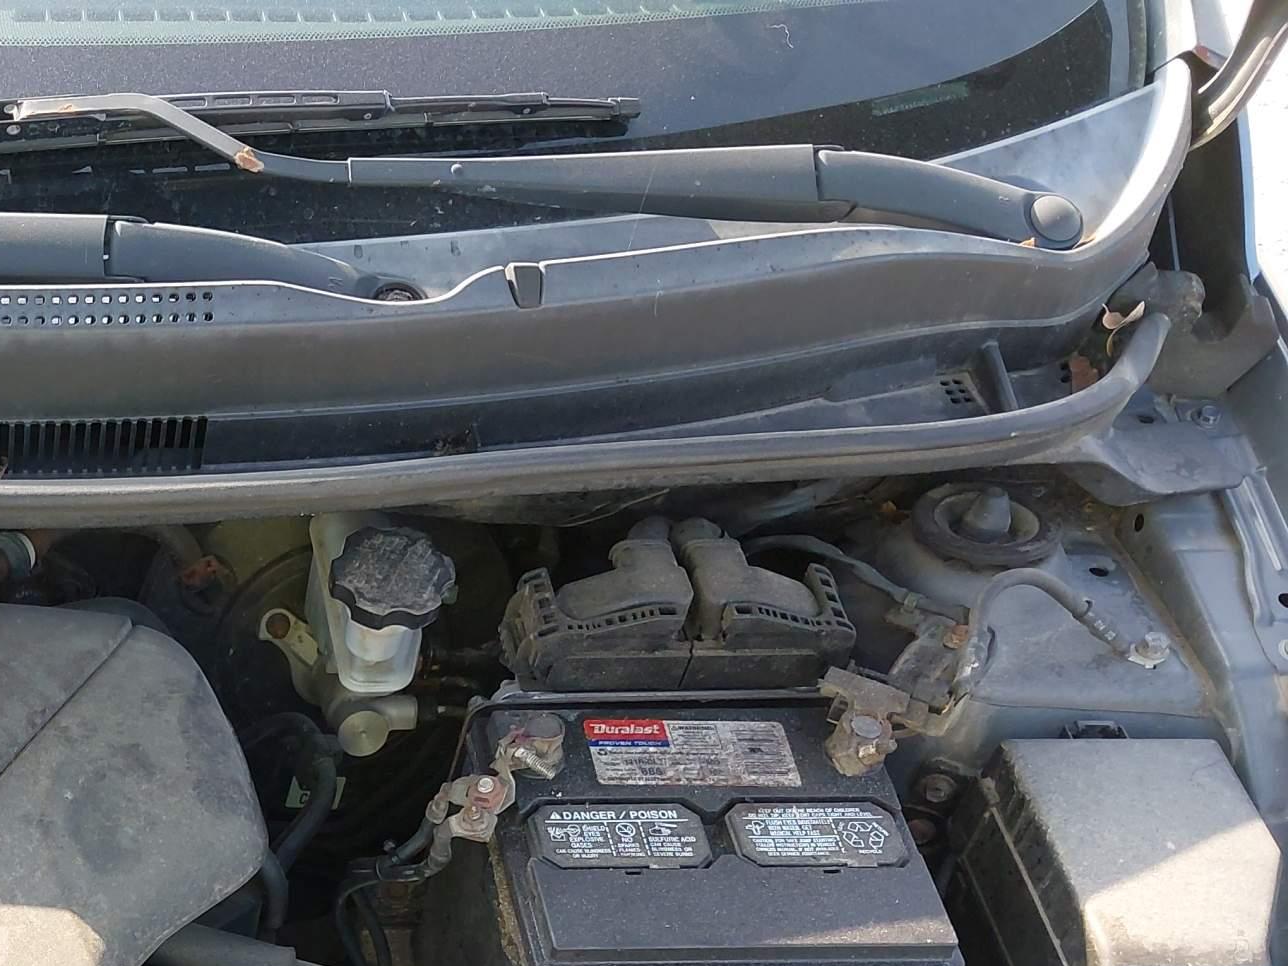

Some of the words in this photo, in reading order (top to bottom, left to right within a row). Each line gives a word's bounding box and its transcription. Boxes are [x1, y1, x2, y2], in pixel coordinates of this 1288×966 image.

[589, 723, 660, 735] Duralast
[562, 811, 617, 819] DANGER
[619, 810, 626, 820] /
[629, 810, 678, 819] POISON
[582, 824, 606, 832] SHIELD
